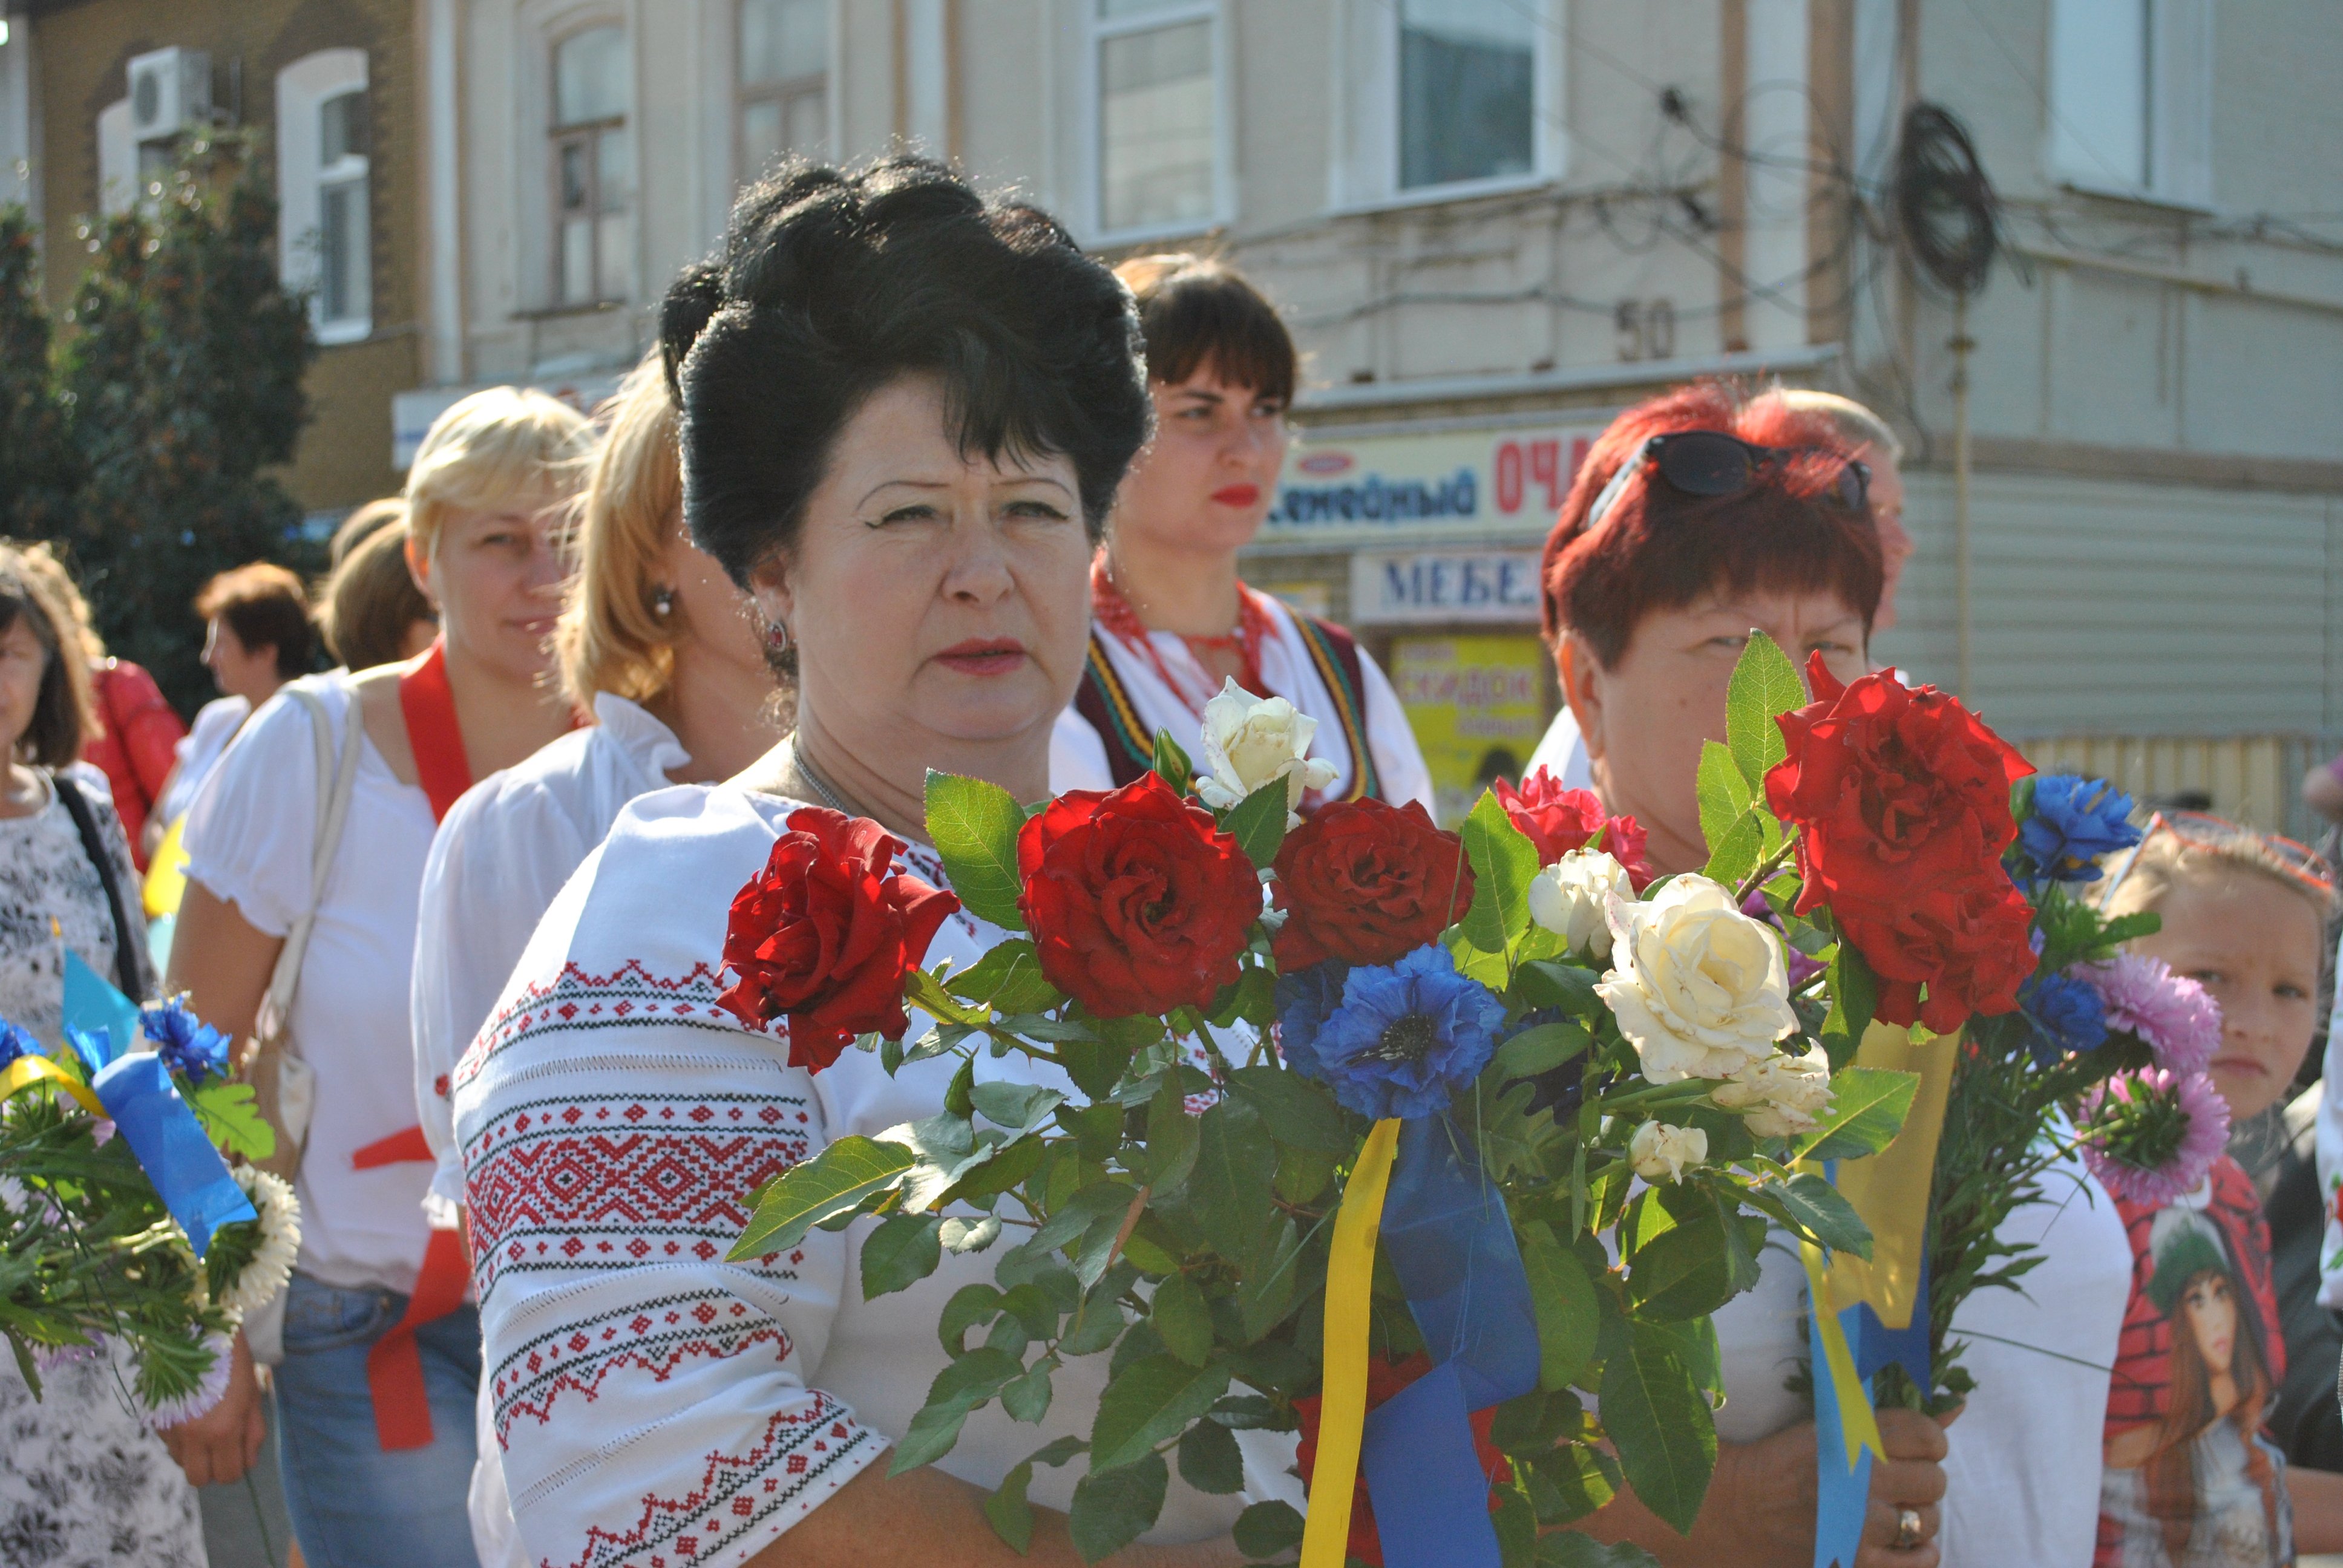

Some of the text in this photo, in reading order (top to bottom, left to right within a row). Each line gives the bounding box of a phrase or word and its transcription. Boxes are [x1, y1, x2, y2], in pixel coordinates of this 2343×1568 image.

[1616, 299, 1674, 362] 50
[1267, 467, 1477, 523] емейный
[1384, 558, 1535, 606] МЕБЕ
